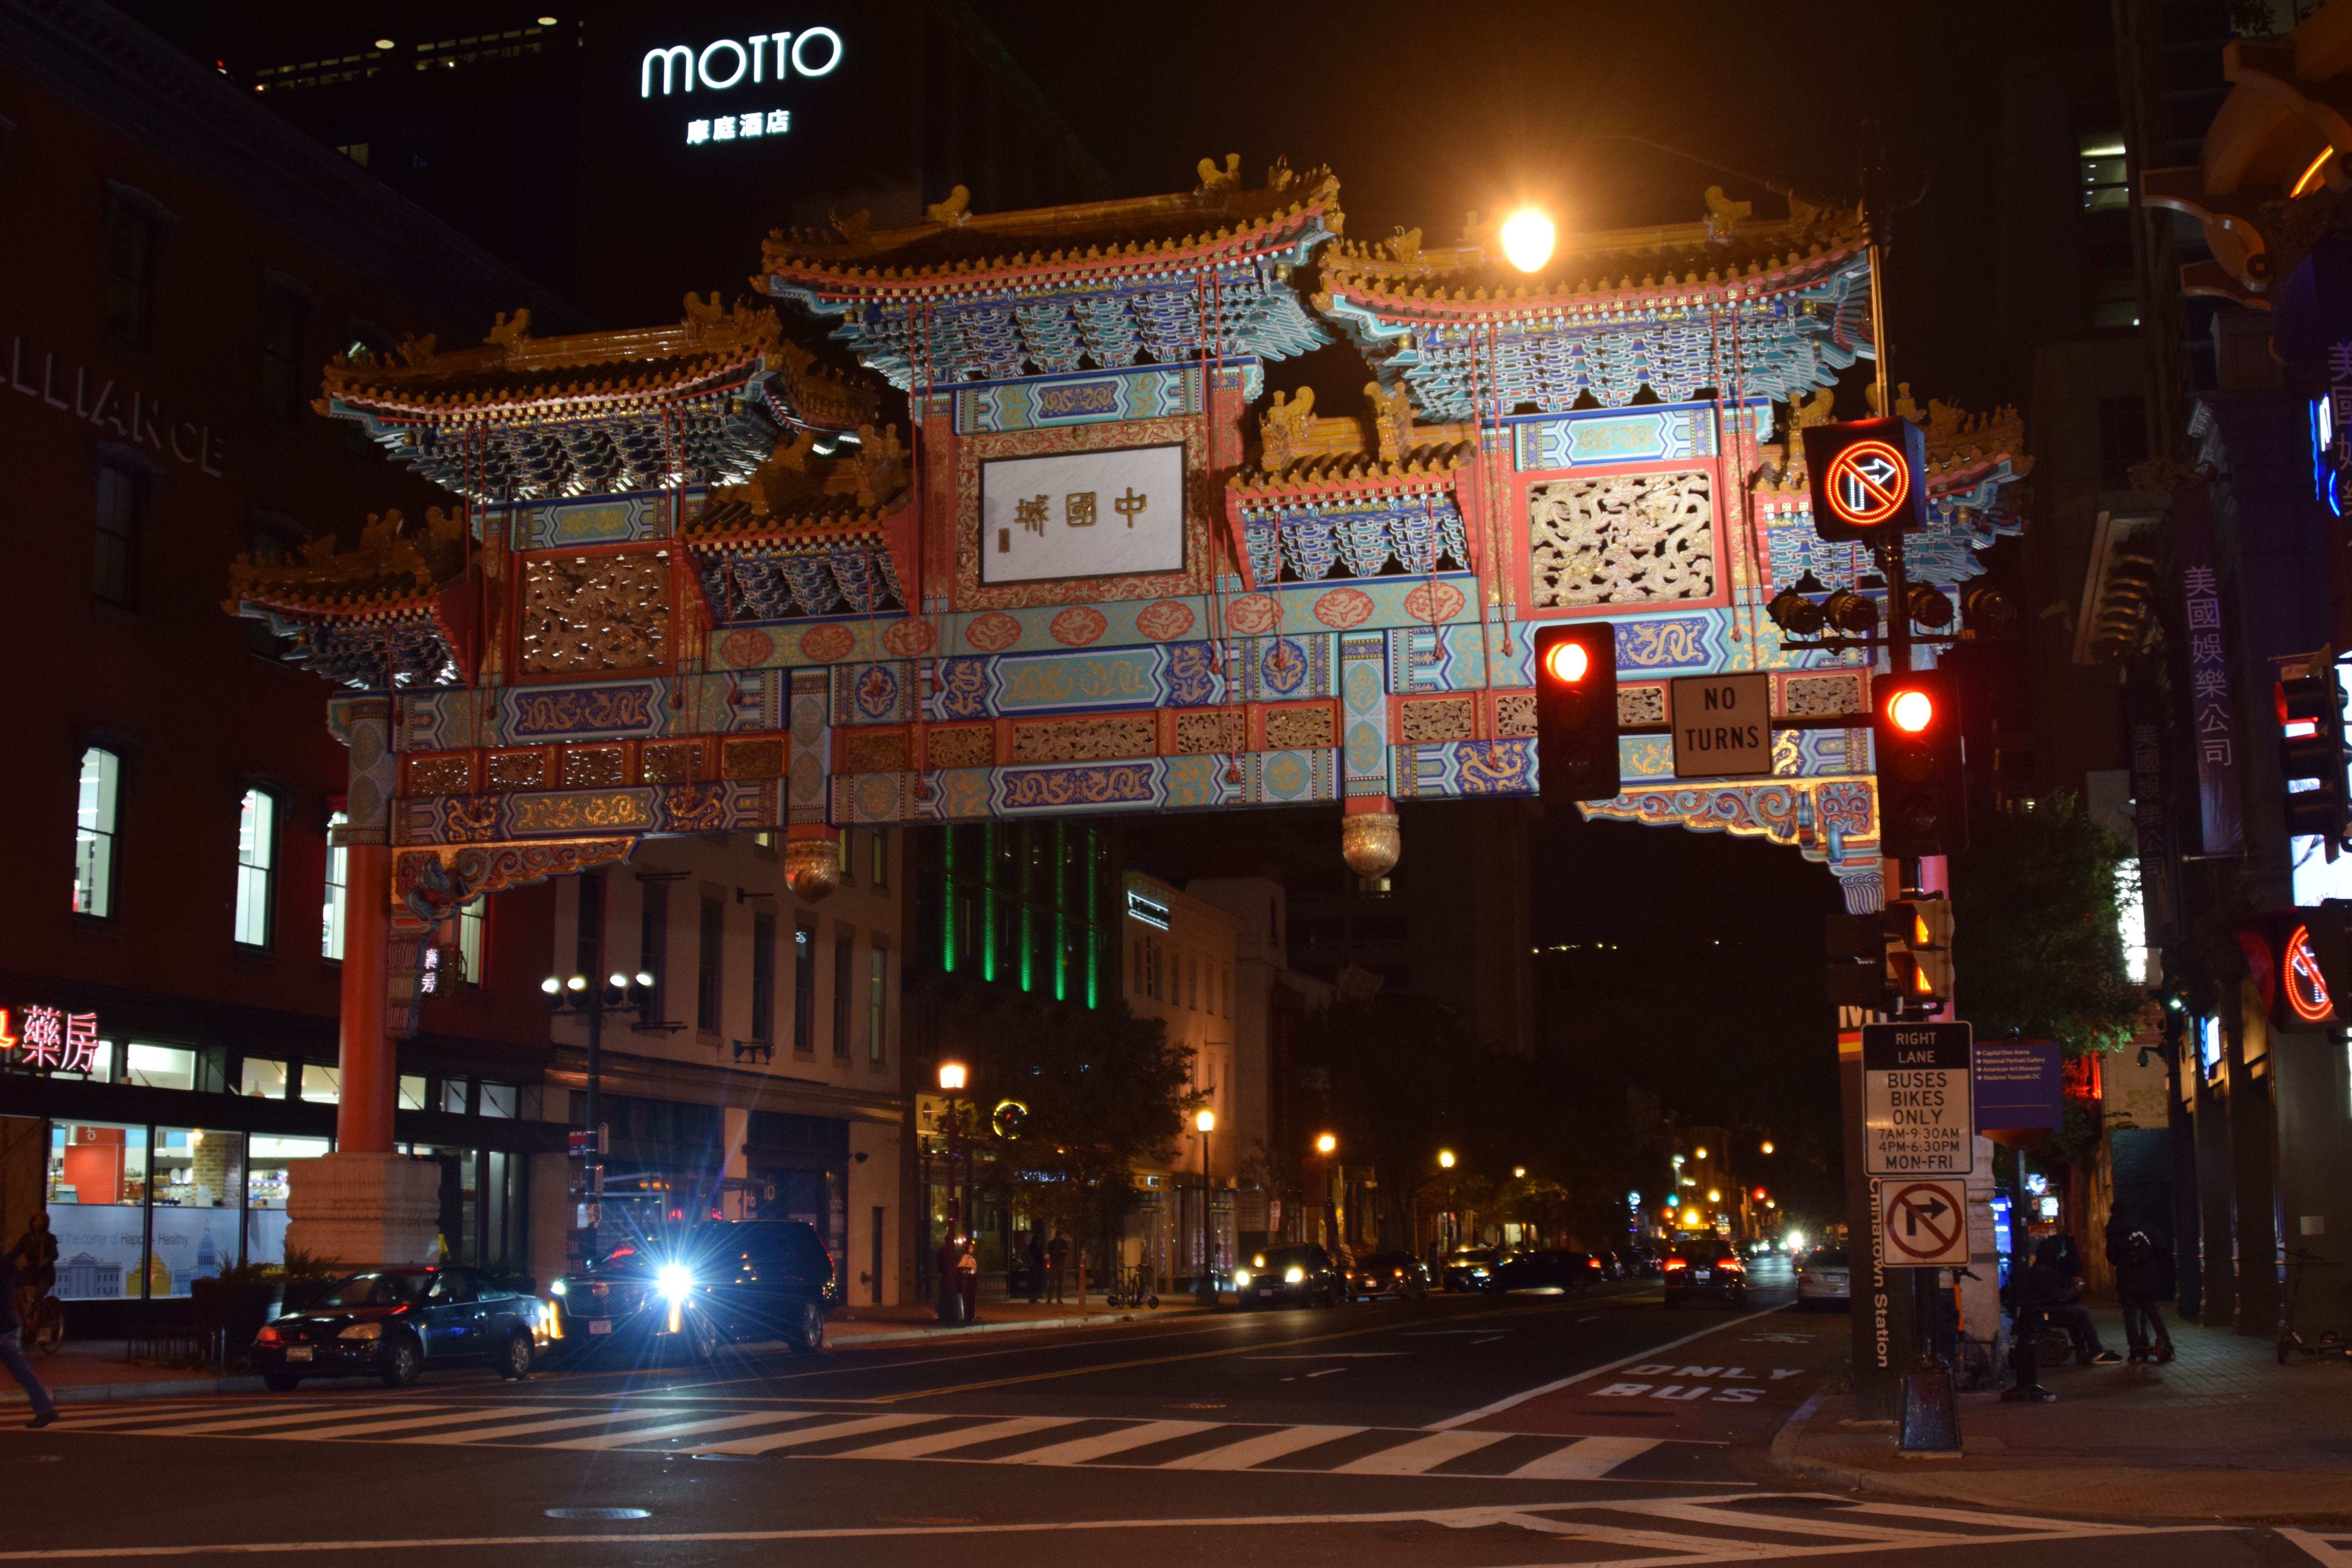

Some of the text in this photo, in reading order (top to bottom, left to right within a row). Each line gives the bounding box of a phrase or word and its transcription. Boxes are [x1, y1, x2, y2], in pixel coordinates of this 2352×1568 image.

[0, 336, 225, 478] LLIANCE
[2184, 564, 2232, 766] 美國娛樂公司
[1705, 687, 1735, 710] NO
[1686, 726, 1759, 751] TURNS
[22, 1005, 99, 1072] 藥房
[1896, 1032, 1936, 1045] RIGHT
[1898, 1051, 1936, 1063] LANE
[1888, 1072, 1947, 1088] BUSES
[1891, 1091, 1944, 1107] BIKES
[1893, 1109, 1943, 1125] ONLY
[1878, 1128, 1960, 1139] 7AM-9:30AM
[1878, 1141, 1960, 1152] 4PM-6:30PM
[1886, 1155, 1953, 1169] MON-FRI
[121, 1233, 143, 1247] Happ
[158, 1233, 189, 1248] Healthy
[1869, 1177, 1888, 1368] Chinatown Station
[1621, 1364, 1806, 1379] ONLY
[1588, 1383, 1767, 1402] BUS
